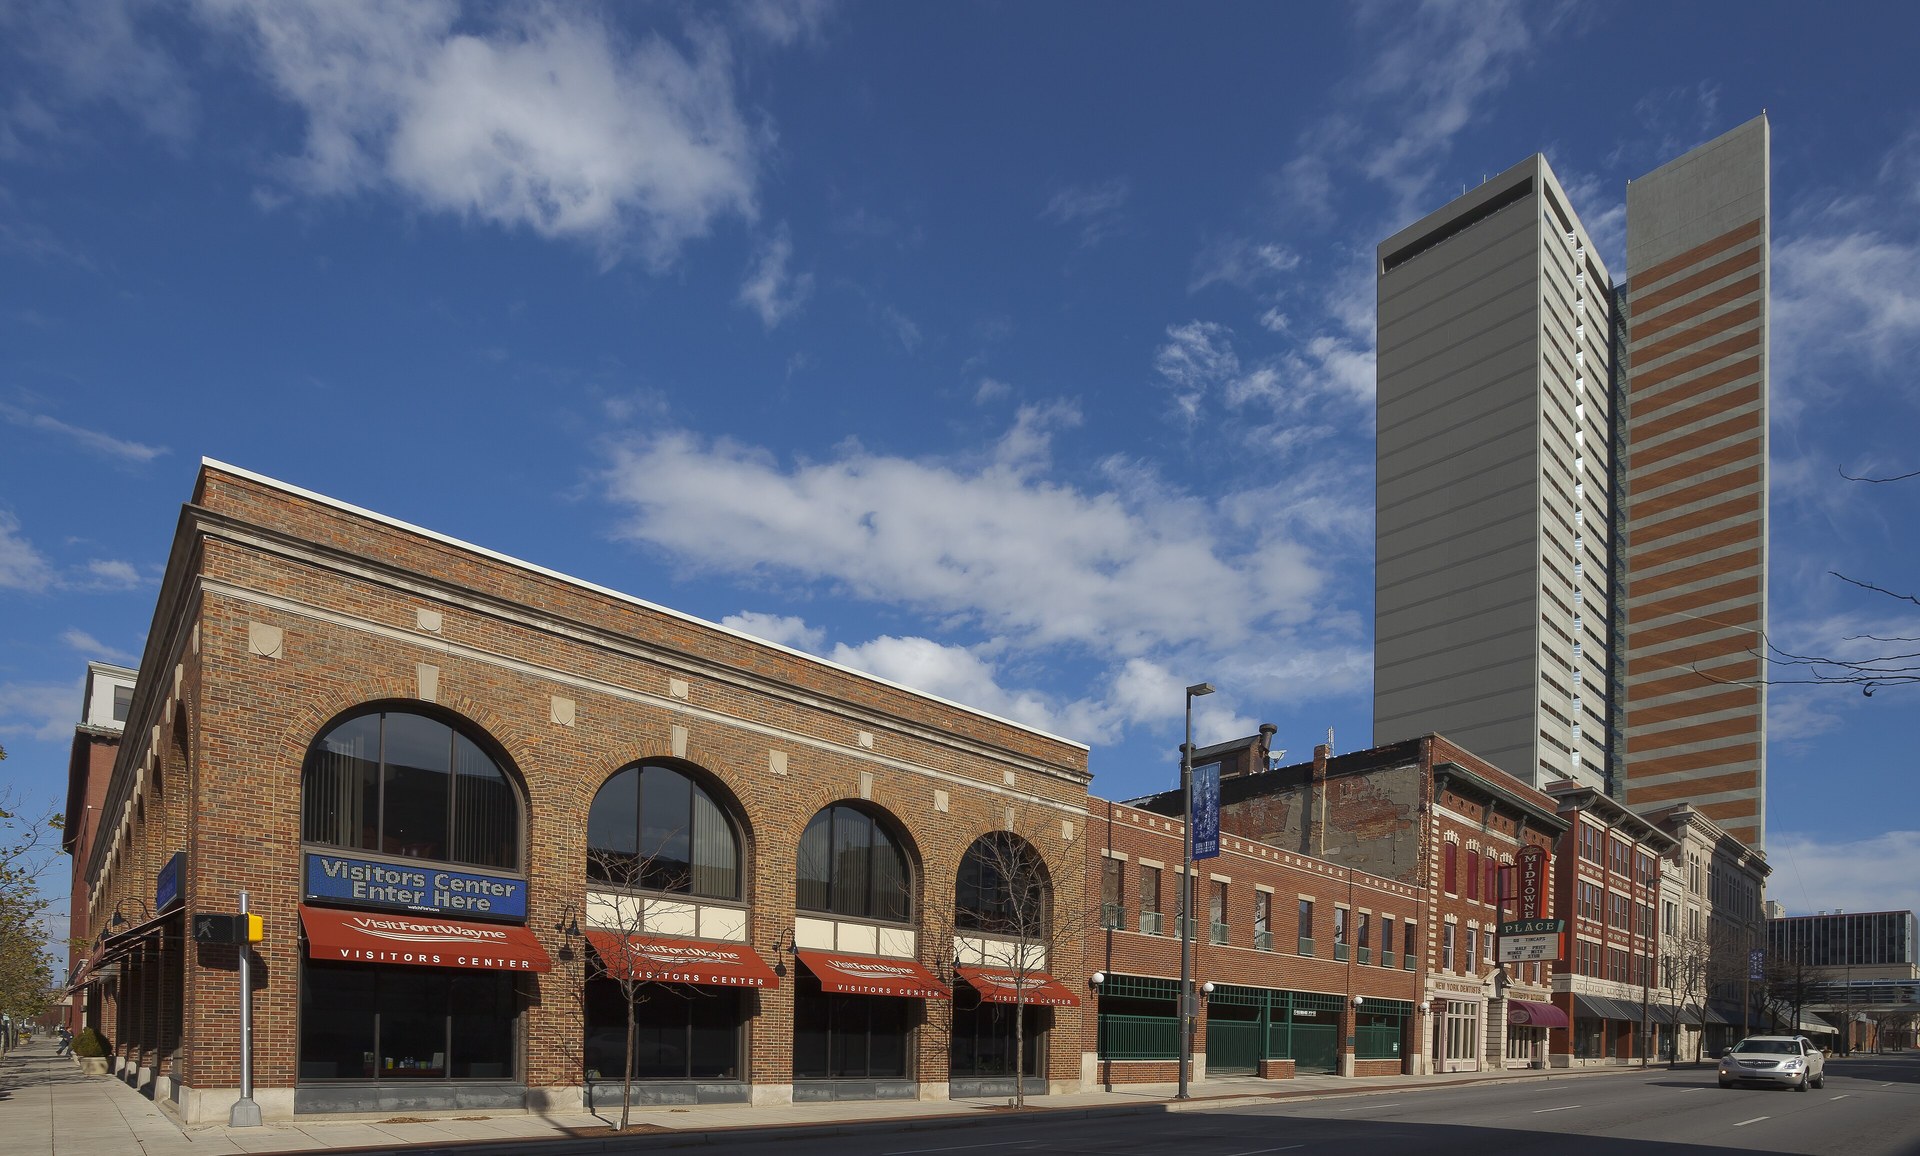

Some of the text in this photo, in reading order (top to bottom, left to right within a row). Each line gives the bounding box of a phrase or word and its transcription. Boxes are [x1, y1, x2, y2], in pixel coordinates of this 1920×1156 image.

[321, 858, 516, 897] Visitors Center
[1523, 854, 1537, 919] MIDTOWNE
[353, 880, 491, 911] Enter Here
[353, 917, 507, 939] VisitFortWayne
[1504, 922, 1555, 933] PLACE
[341, 949, 529, 968] VISITORS CENTER
[711, 976, 764, 986] CENTER
[1435, 982, 1482, 994] NEW YORK DENTISTS
[837, 984, 940, 997] VISITORS CENTER
[994, 994, 1034, 1003] VISITRS
